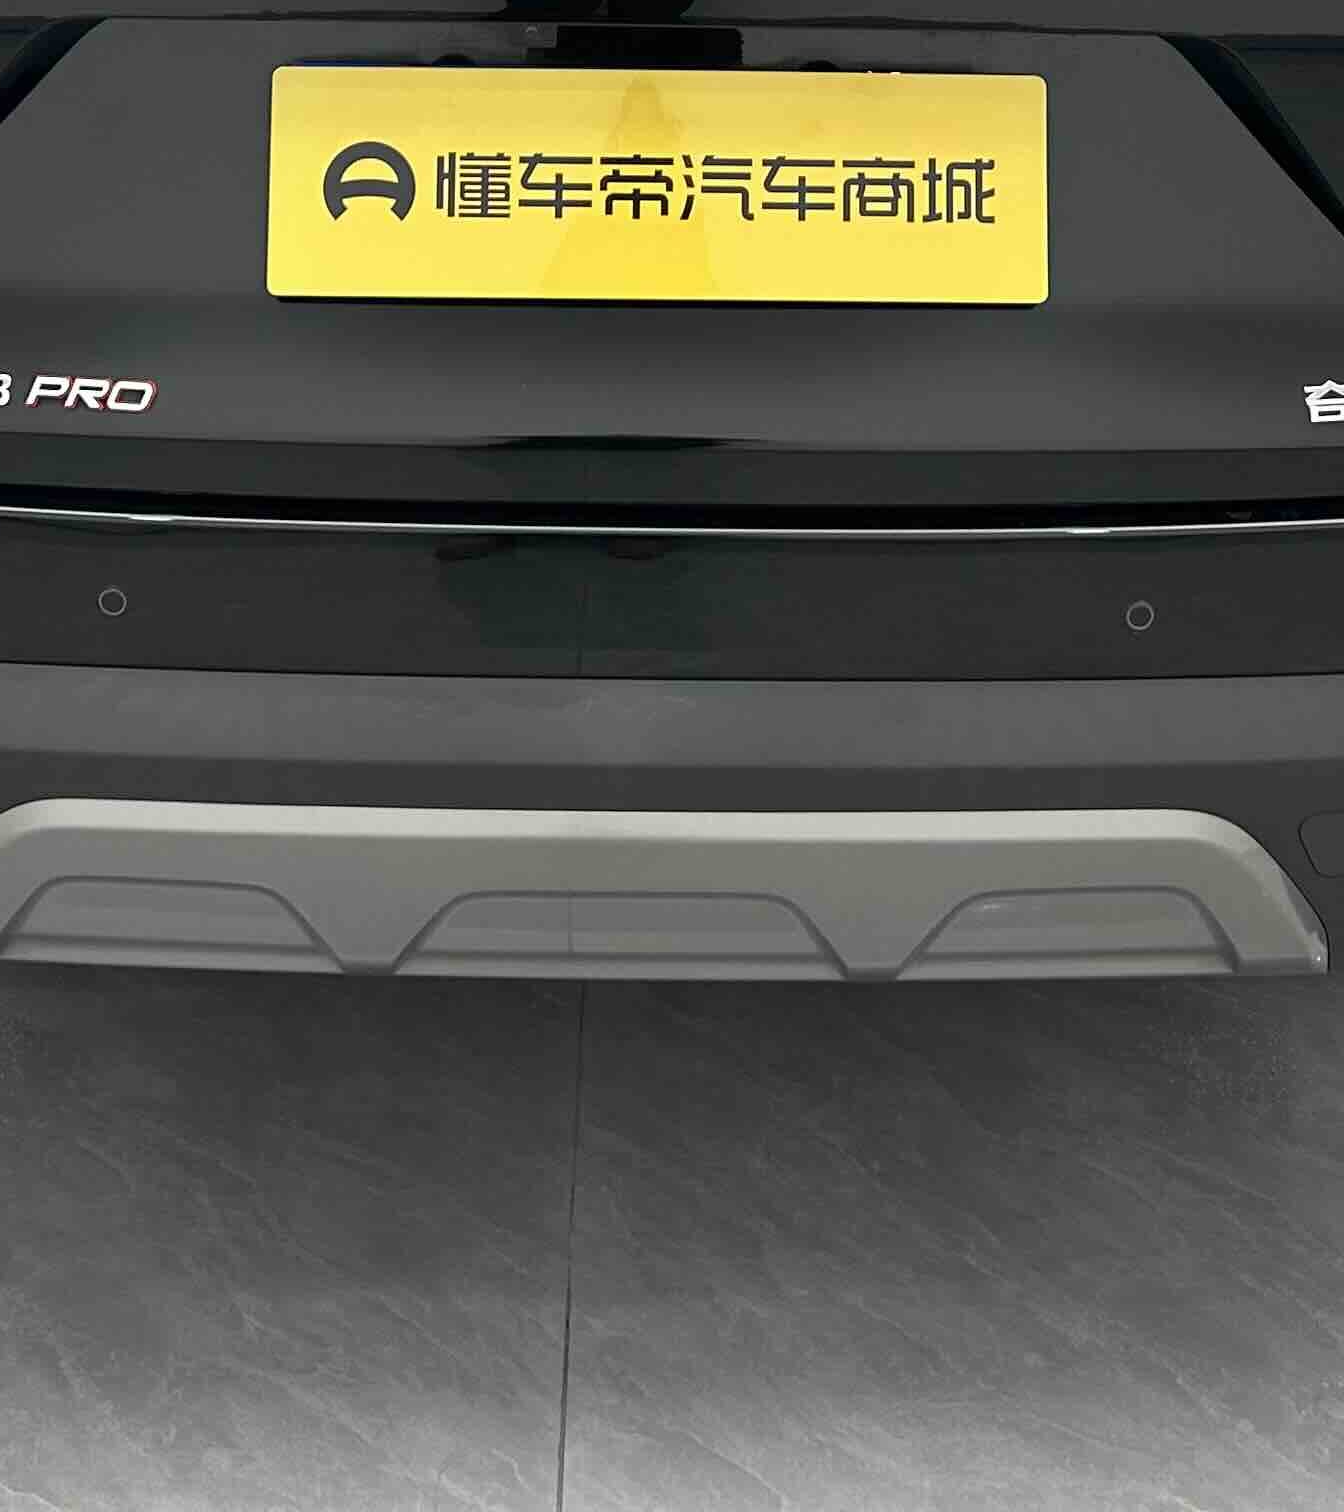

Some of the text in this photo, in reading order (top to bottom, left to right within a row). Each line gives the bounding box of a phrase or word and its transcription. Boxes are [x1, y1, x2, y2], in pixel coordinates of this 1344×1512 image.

[435, 150, 996, 224] 懂车帝汽车商城
[24, 374, 158, 412] PRO
